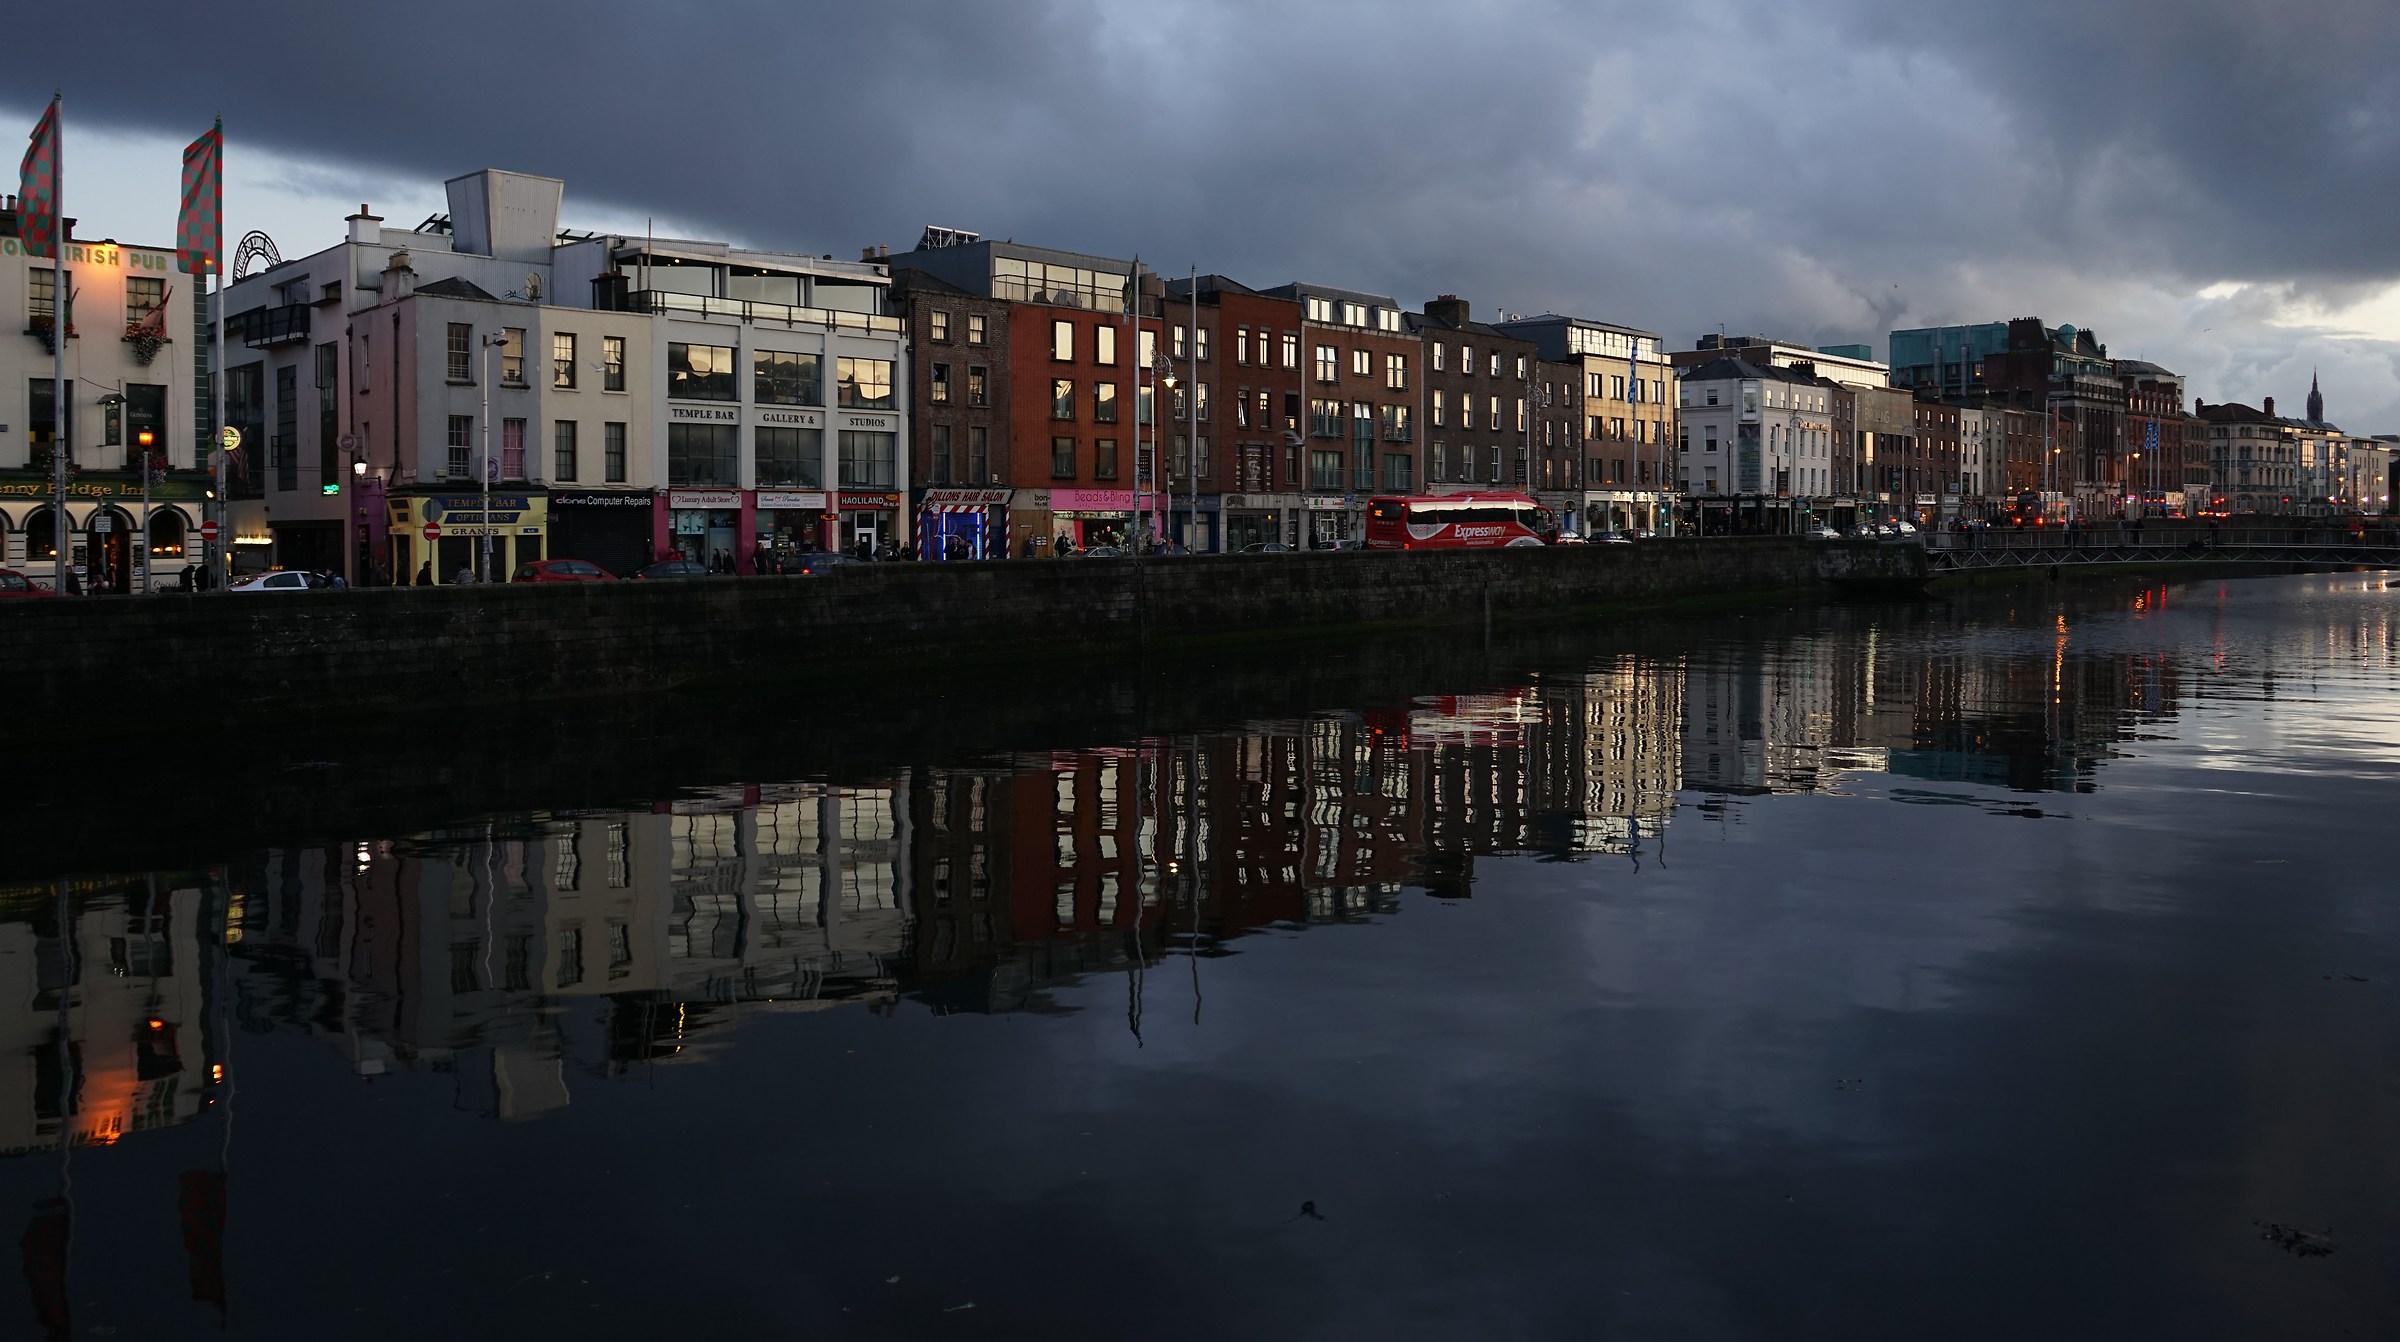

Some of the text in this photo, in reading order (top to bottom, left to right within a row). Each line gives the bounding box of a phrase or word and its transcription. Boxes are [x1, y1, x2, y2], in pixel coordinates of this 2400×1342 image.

[65, 245, 168, 272] IRISH PUB
[672, 408, 735, 420] TEMPLE BAR
[763, 413, 815, 424] GALLERY &
[849, 417, 885, 427] STUDIOS
[587, 495, 623, 507] Computer
[624, 496, 651, 507] Repairs
[681, 496, 700, 504] Luxury
[841, 496, 884, 505] HAOLILAND
[931, 491, 1005, 502] DILLONS HAIR SALON
[1074, 490, 1103, 502] Beads
[1110, 490, 1131, 504] Bling
[448, 499, 516, 508] TEMPL BAR
[1454, 524, 1506, 541] Expressway
